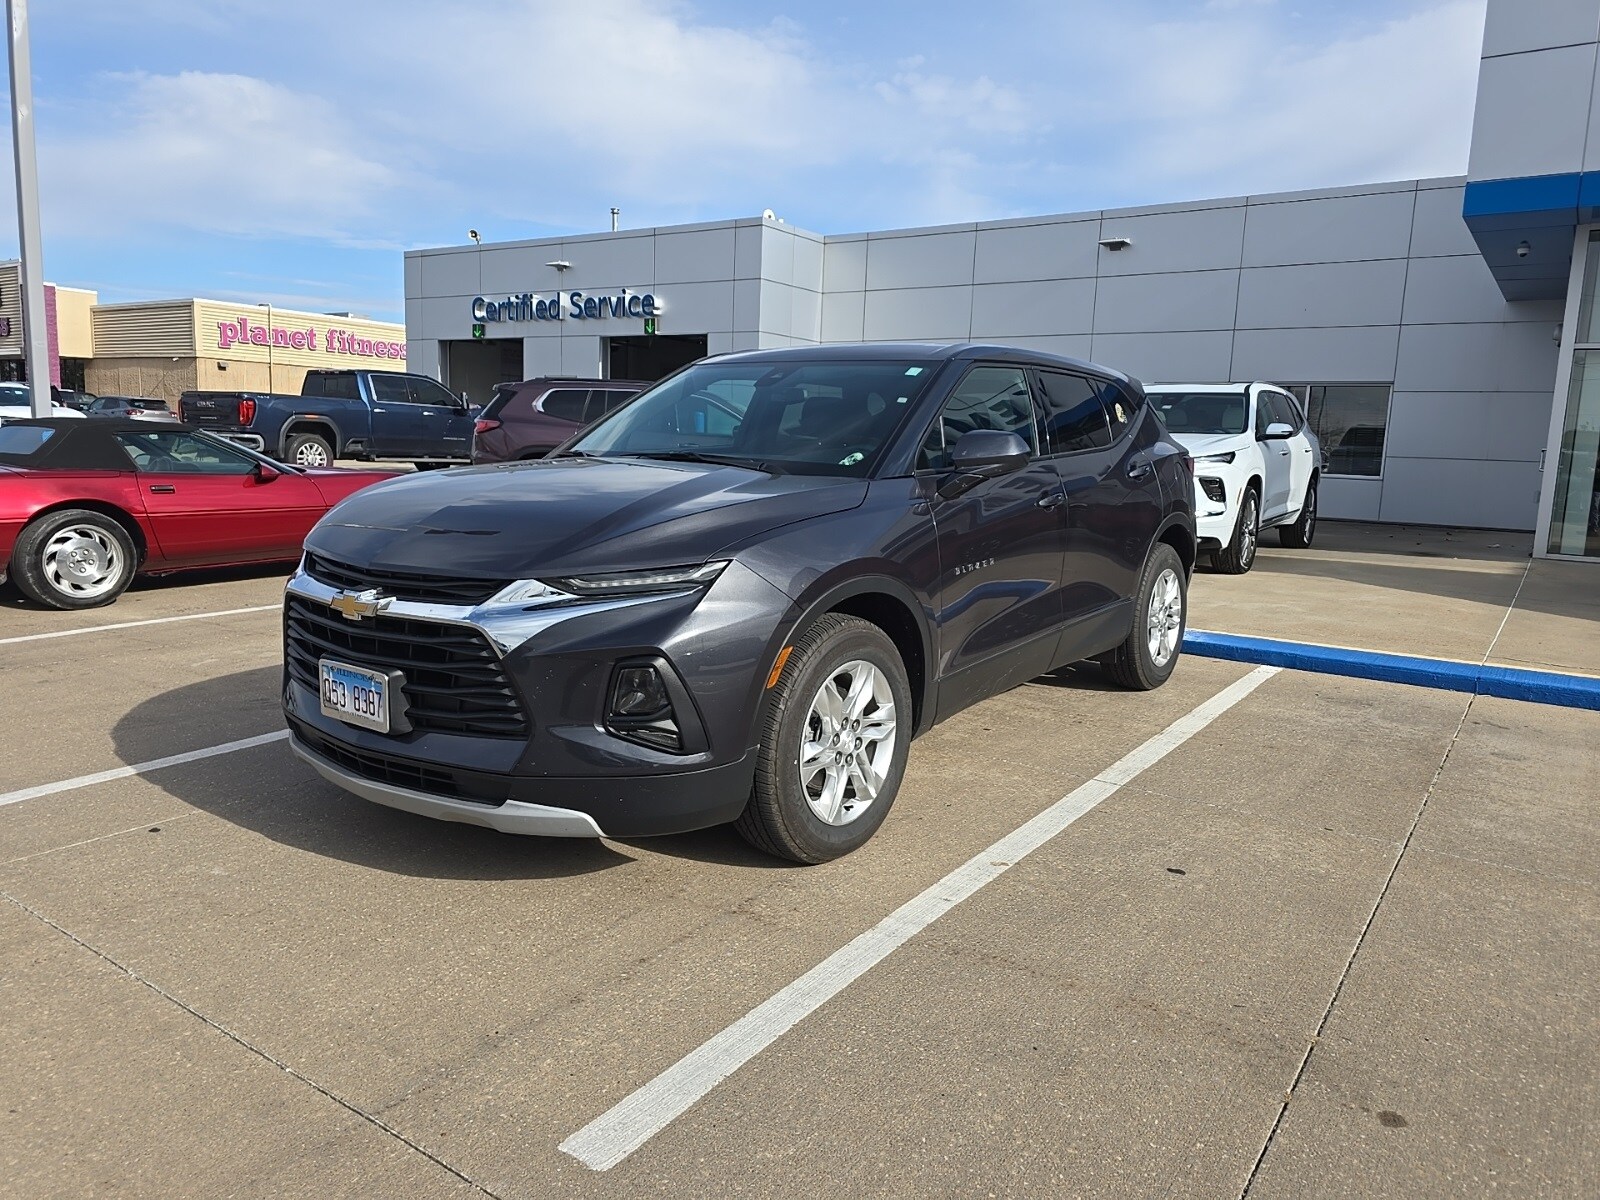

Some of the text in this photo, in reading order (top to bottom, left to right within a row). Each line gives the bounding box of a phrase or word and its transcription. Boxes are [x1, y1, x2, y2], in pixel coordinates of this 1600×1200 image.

[472, 288, 655, 322] Certified Service
[217, 316, 317, 350] planet
[353, 685, 382, 718] 8387
